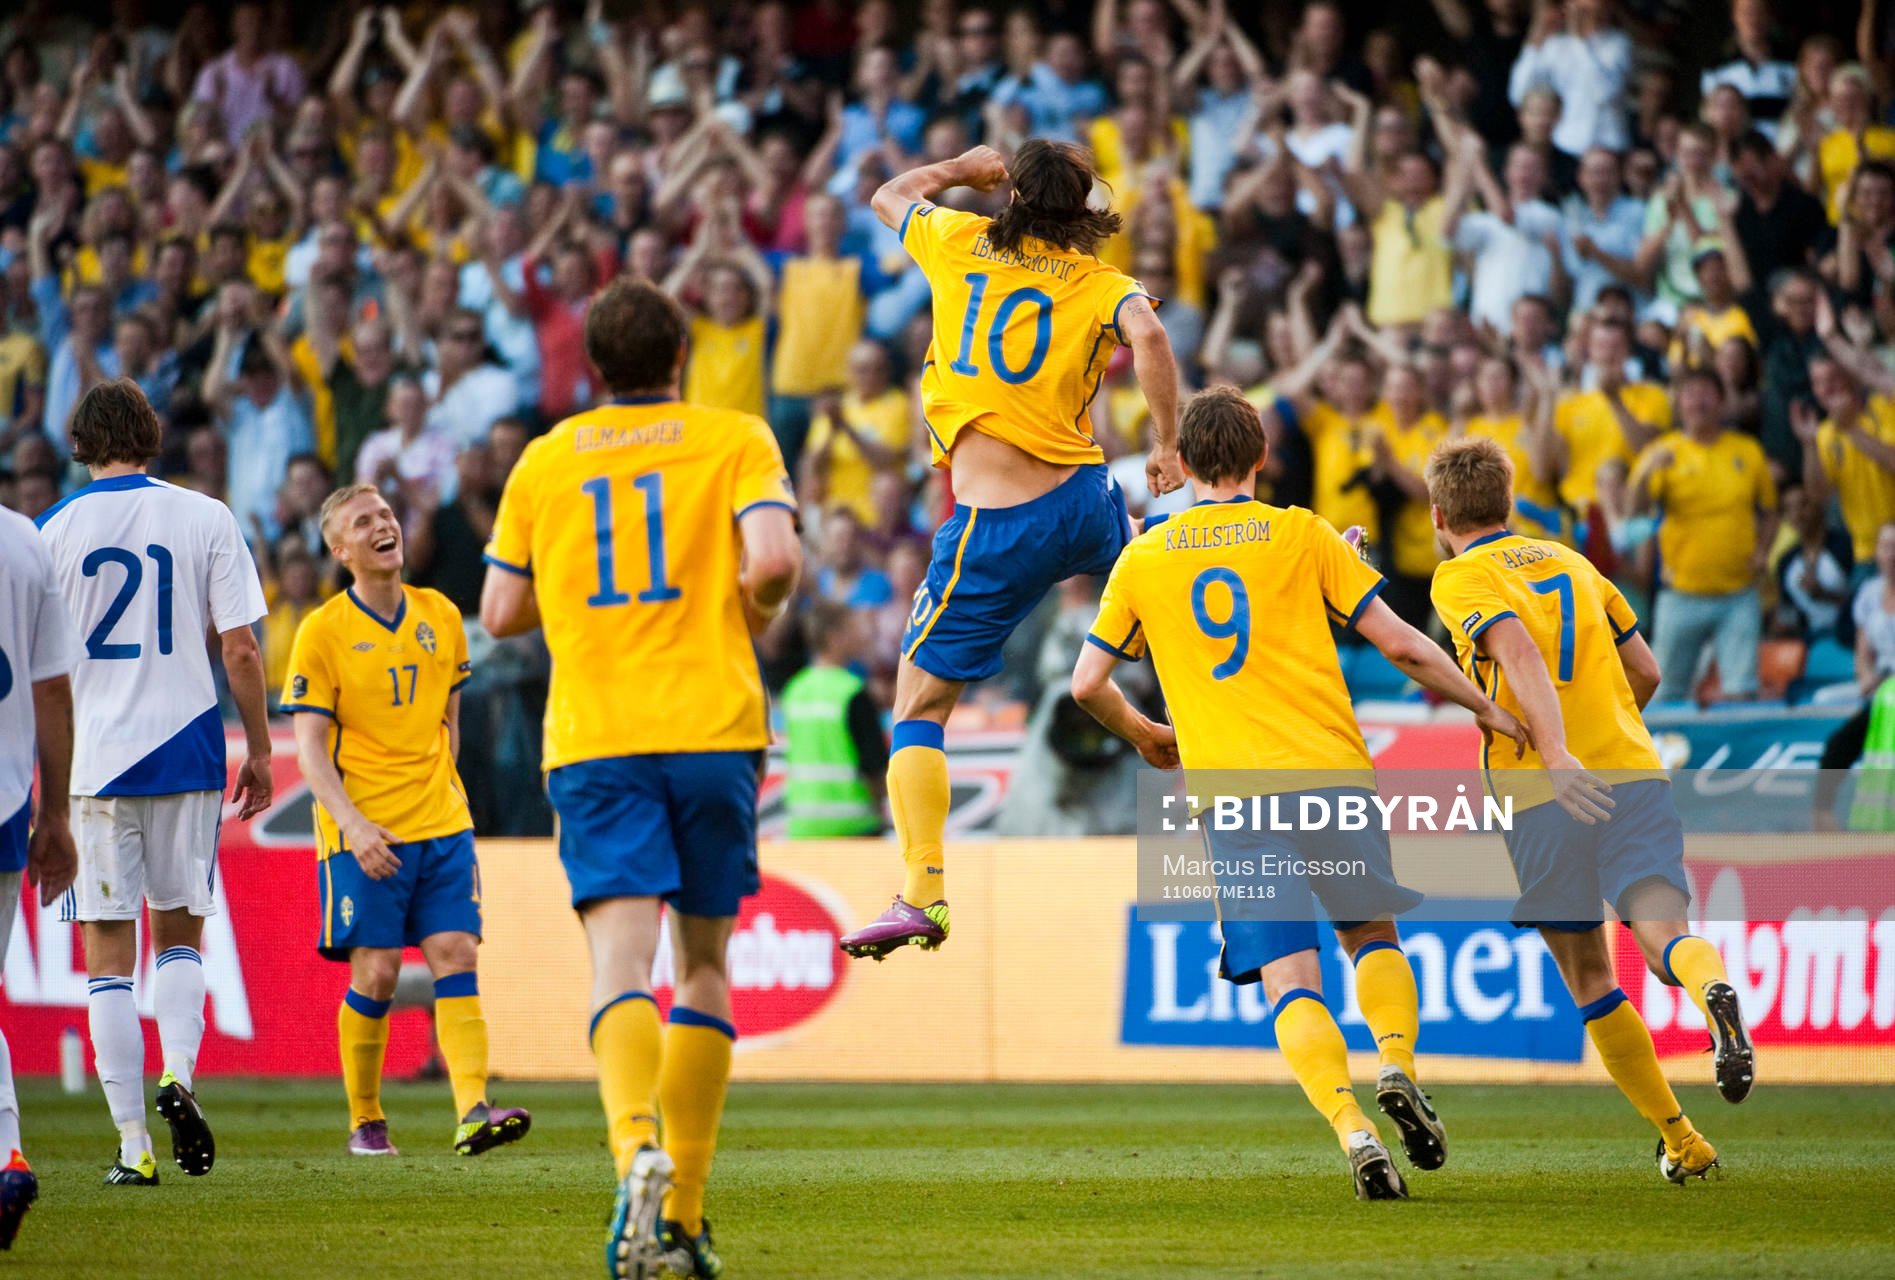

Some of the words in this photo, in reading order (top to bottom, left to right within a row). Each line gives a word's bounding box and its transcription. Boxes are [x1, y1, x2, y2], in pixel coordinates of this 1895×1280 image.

[950, 272, 1053, 385] 10
[581, 471, 683, 607] 11
[1164, 516, 1272, 552] KÄLLSTRÖM
[82, 543, 174, 660] 21
[1190, 566, 1251, 681] 9
[1525, 572, 1576, 682] 7
[387, 663, 418, 707] 17
